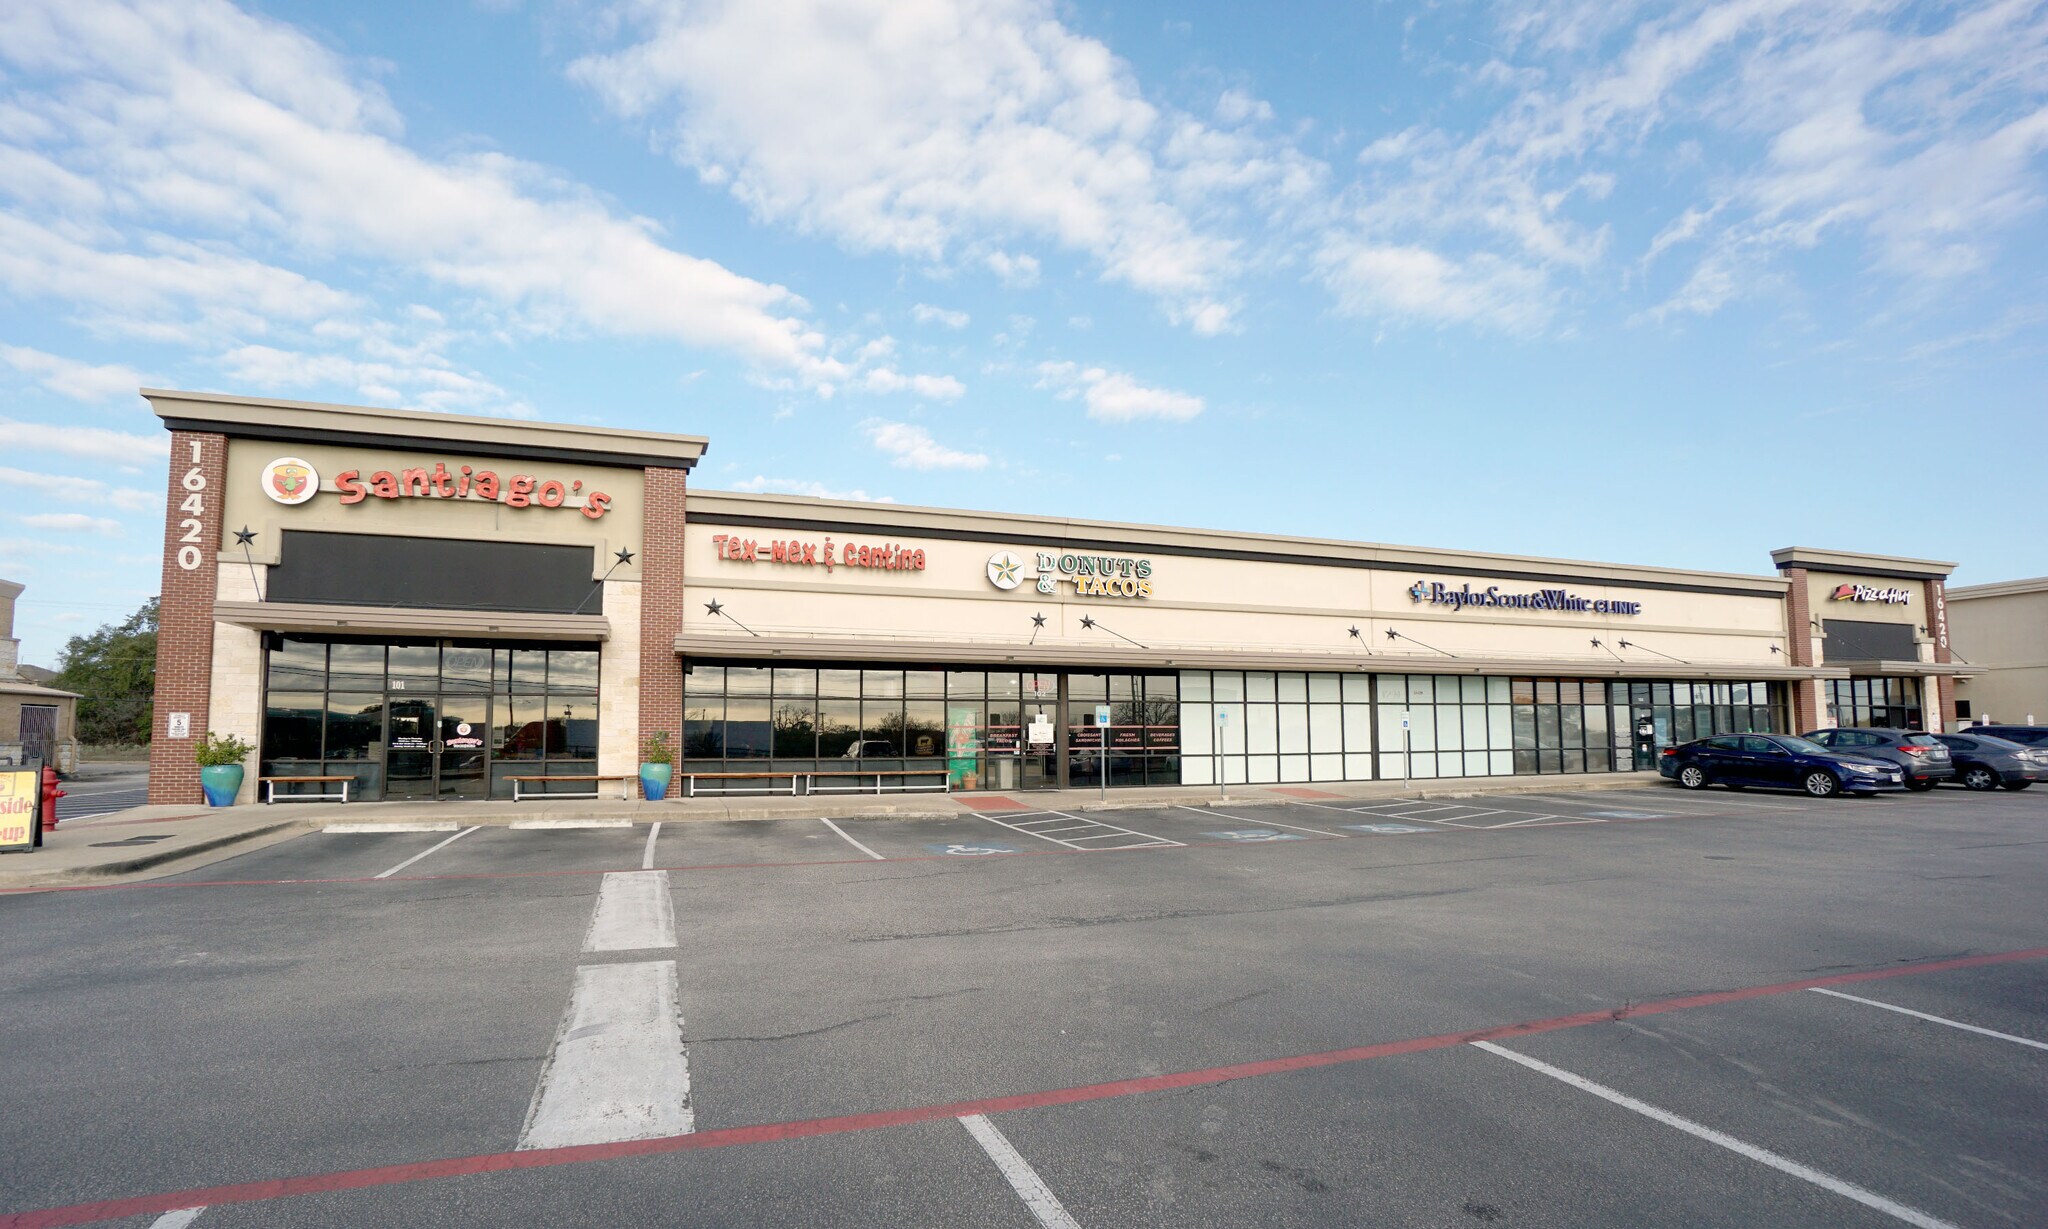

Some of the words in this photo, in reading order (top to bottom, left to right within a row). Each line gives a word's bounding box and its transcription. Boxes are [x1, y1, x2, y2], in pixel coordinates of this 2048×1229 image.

[178, 441, 206, 570] 16420
[1037, 552, 1153, 578] DONUTS
[1037, 574, 1058, 594] &
[1072, 575, 1154, 598] TACOS
[1593, 599, 1642, 615] CLINIC
[1936, 584, 1948, 649] 16420
[392, 681, 405, 690] 101
